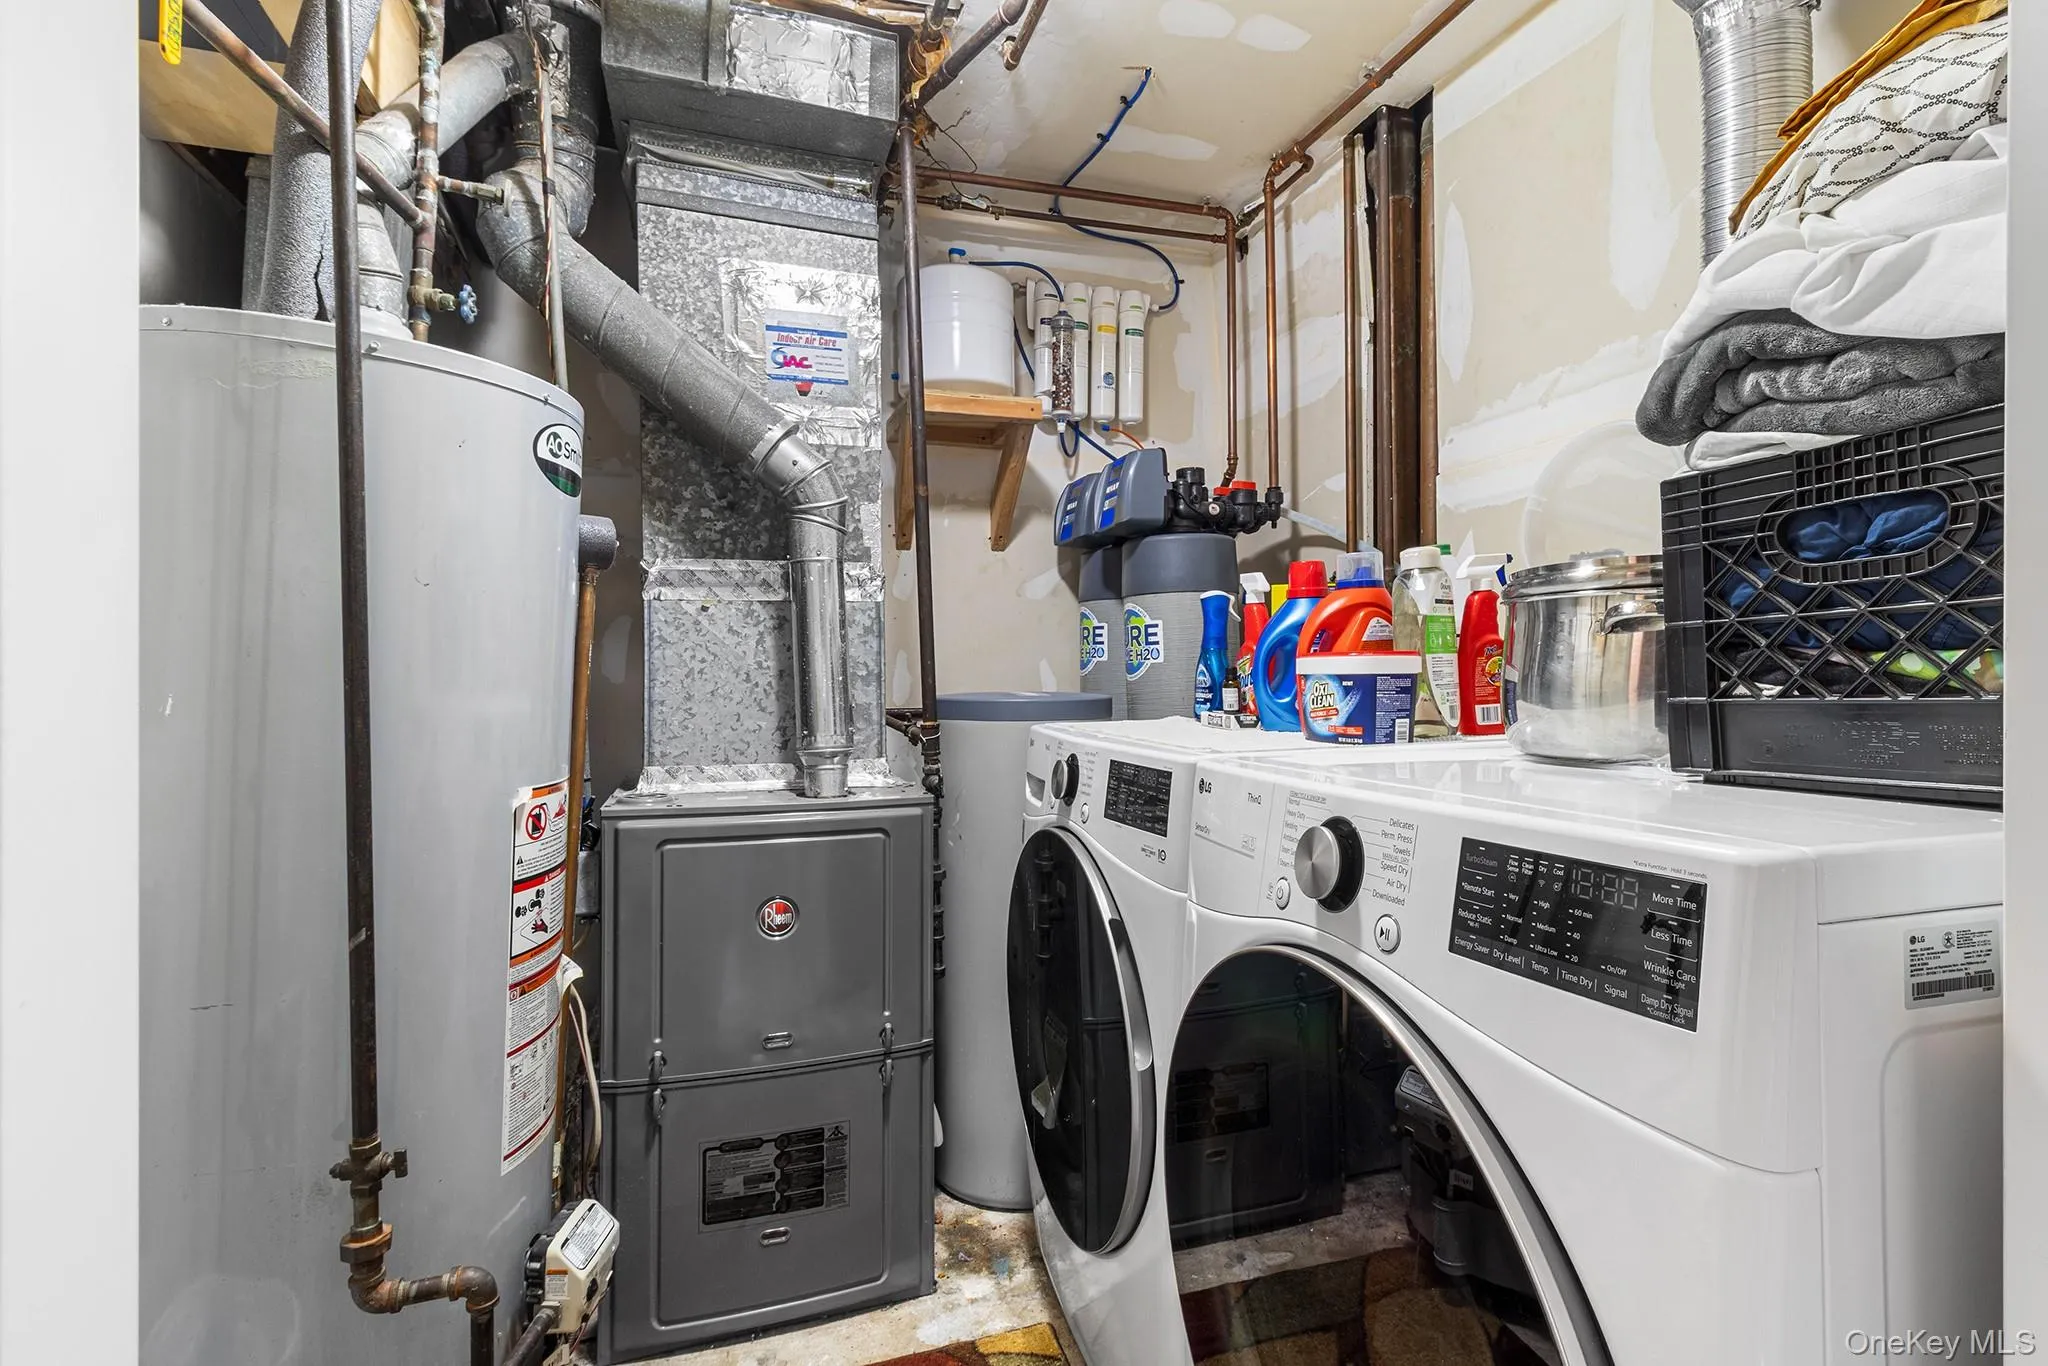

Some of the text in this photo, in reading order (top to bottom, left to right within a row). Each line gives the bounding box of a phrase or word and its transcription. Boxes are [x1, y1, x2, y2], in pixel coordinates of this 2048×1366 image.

[777, 333, 803, 344] Indoor
[805, 337, 817, 346] Air
[819, 338, 837, 348] Care
[1080, 625, 1105, 646] RE
[1313, 681, 1329, 696] OXI
[1310, 693, 1335, 709] CLEAN
[1247, 792, 1262, 807] ThinQ
[1389, 818, 1415, 831] Delicates
[1397, 832, 1413, 846] Press
[1392, 844, 1411, 858] Towels
[1465, 852, 1498, 868] TurboSteam
[1521, 861, 1534, 870] Clean
[1380, 861, 1408, 878] Speed Dry
[1538, 865, 1547, 875] Dry
[1553, 868, 1564, 877] Cool
[1386, 878, 1407, 893] Air Dry
[1482, 887, 1496, 898] Start
[1372, 889, 1406, 906] Downloaded
[1508, 893, 1519, 903] Very
[1538, 900, 1550, 910] High
[1652, 892, 1697, 911] More Time
[764, 903, 793, 930] Rheem
[1458, 908, 1492, 926] Reduce Static
[1506, 914, 1523, 924] Normal
[1574, 908, 1593, 919] 60 min
[1536, 922, 1557, 934] Medium
[1504, 934, 1518, 946] Damp
[1572, 931, 1581, 941] 40
[1651, 928, 1693, 948] Less Time
[1454, 935, 1490, 955] Energy Saver
[1534, 944, 1558, 957] Ultra Low
[1493, 948, 1522, 966] Dry Level
[1570, 954, 1579, 964] 20
[1531, 960, 1550, 975] Temp.
[1606, 964, 1627, 976] On/Off
[1643, 960, 1697, 984] Wrinkle Care
[1561, 970, 1594, 990] Time Dry
[1670, 978, 1685, 991] Light
[1604, 984, 1628, 1001] Signal
[1641, 993, 1694, 1020] Damp Dry Signal
[1671, 1013, 1686, 1025] Lock
